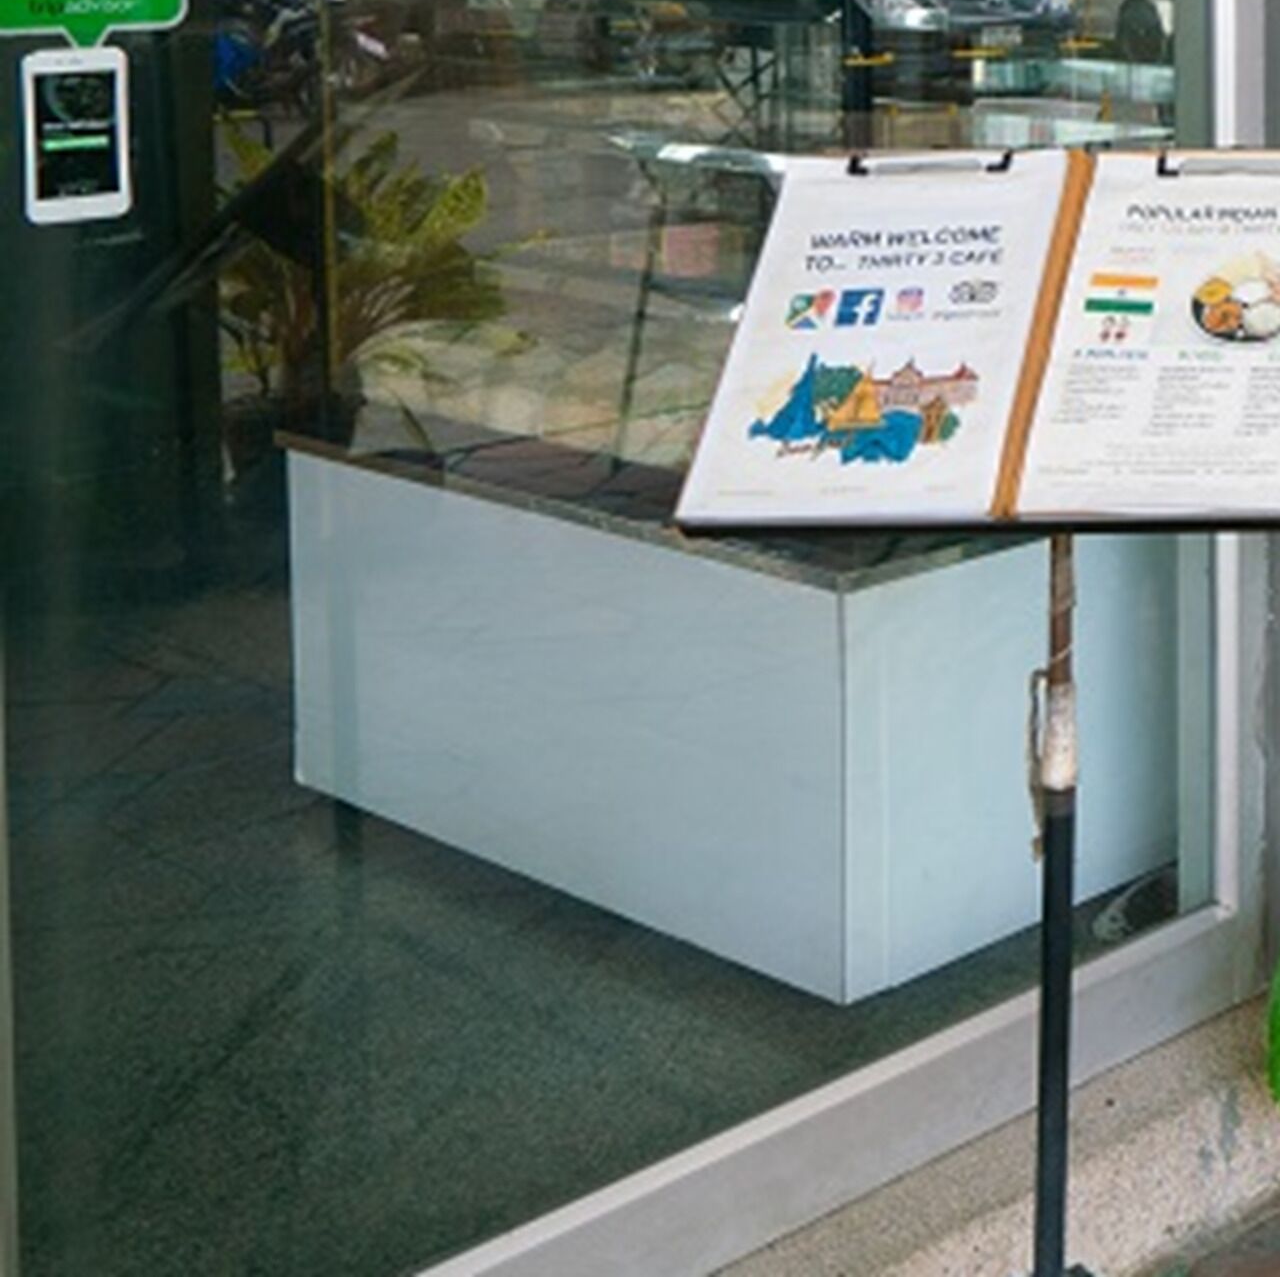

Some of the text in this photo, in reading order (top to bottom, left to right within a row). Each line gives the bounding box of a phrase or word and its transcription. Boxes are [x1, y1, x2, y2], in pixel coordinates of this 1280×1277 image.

[811, 225, 1003, 250] WARM WELCOME
[949, 247, 1004, 266] CAFE
